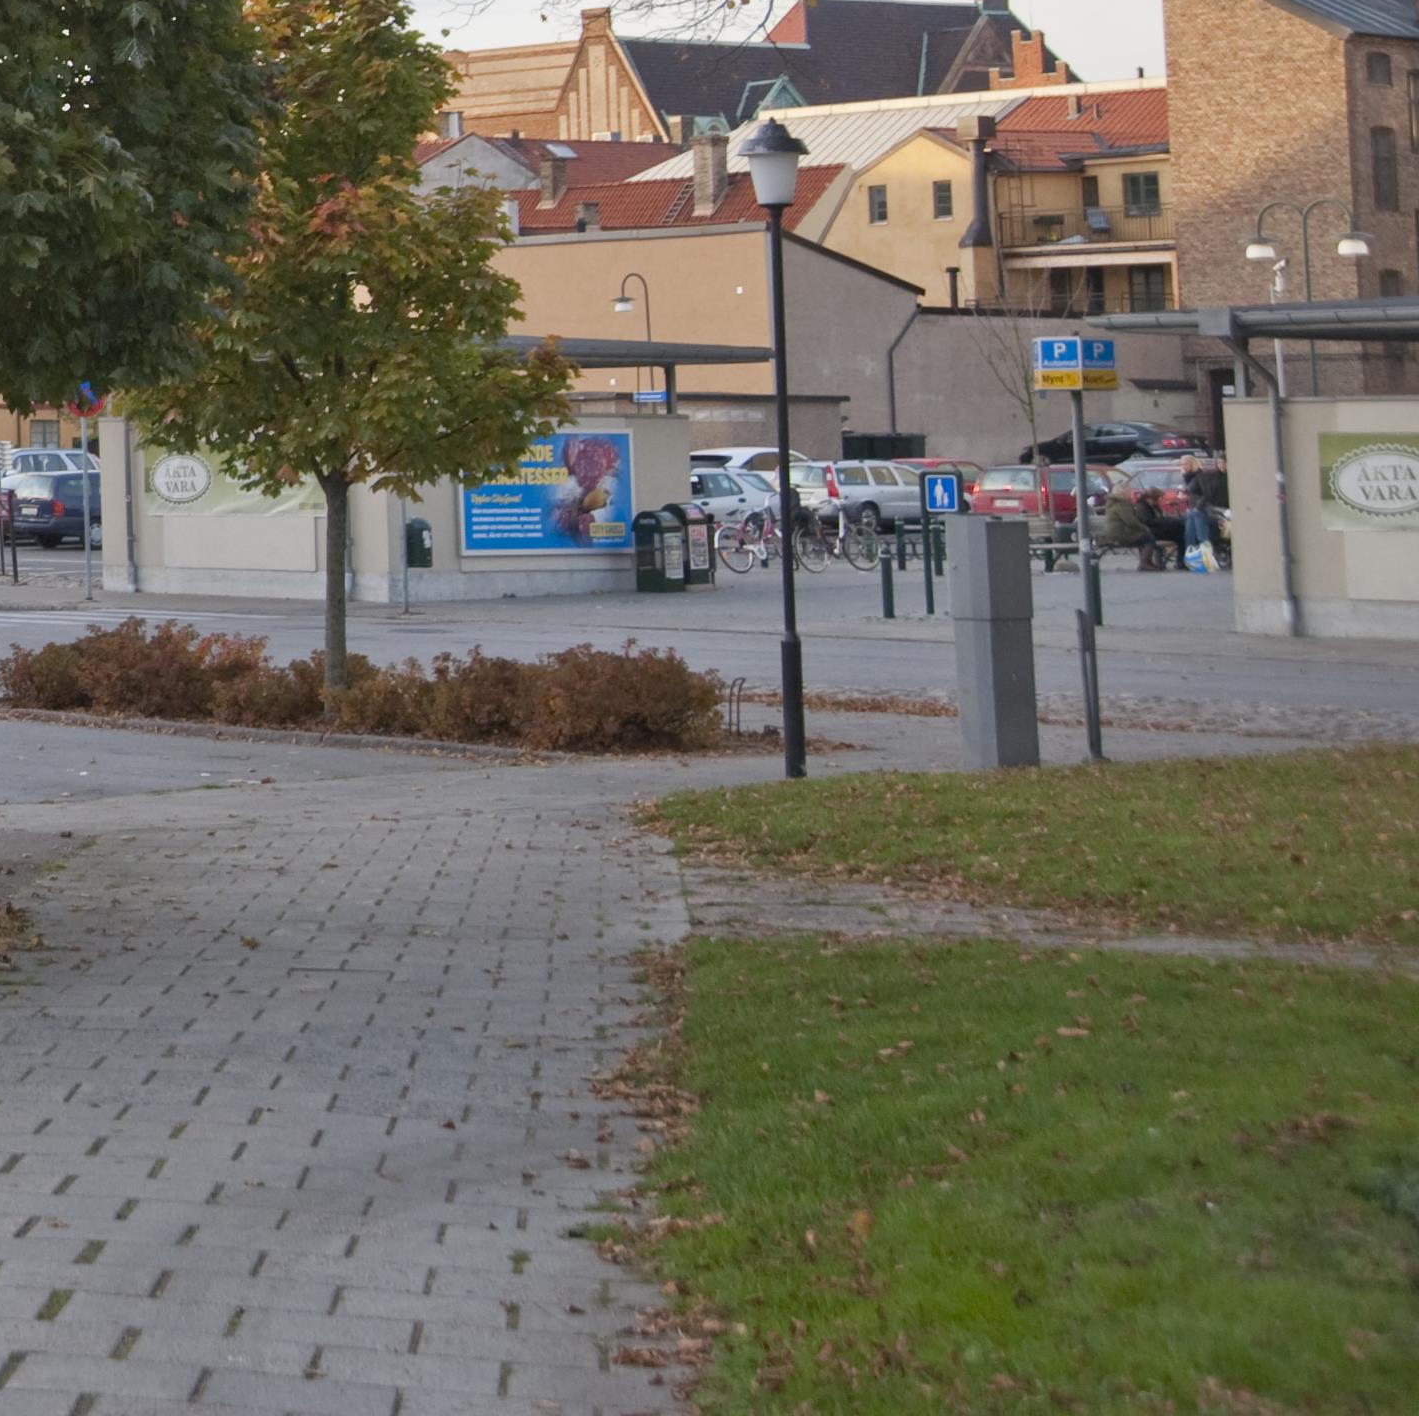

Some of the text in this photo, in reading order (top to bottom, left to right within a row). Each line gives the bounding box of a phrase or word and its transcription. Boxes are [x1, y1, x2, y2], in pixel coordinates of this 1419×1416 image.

[1053, 342, 1066, 359] P
[1093, 342, 1105, 359] P
[166, 463, 197, 478] ÄKTA
[1357, 462, 1417, 481] ÄKTA
[165, 481, 197, 494] VARA
[1358, 485, 1418, 500] VARA
